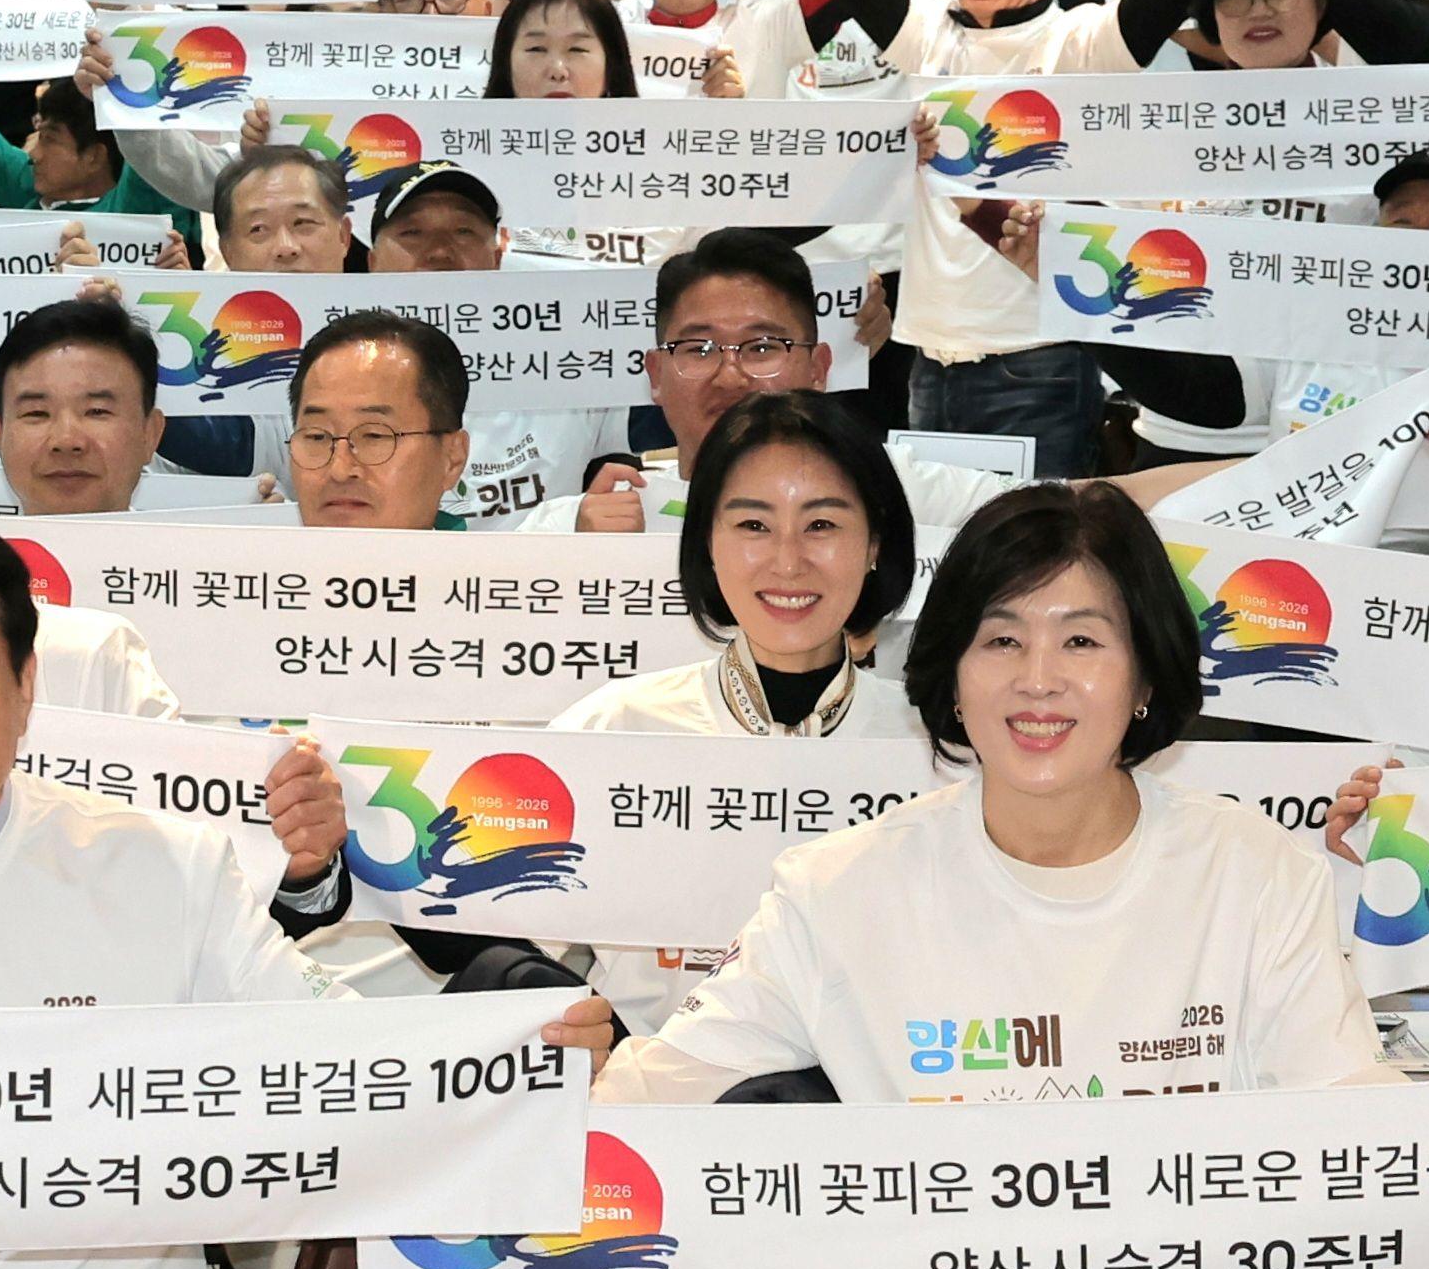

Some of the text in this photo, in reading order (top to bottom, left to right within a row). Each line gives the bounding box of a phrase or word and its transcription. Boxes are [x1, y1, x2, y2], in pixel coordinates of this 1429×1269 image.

[441, 126, 907, 155] 함께 꽃피운 30년 새로운 발걸음 100년
[1229, 251, 1281, 282] 함께
[1292, 256, 1373, 288] 꽃피운
[102, 566, 563, 613] 함께 꽃피운 30년 새로운
[472, 812, 549, 832] Yangsan
[609, 783, 833, 832] 함께 꽃피운
[1181, 1004, 1224, 1027] 2026
[906, 1014, 1062, 1074] 양산에
[1206, 1034, 1225, 1057] 해
[89, 1066, 241, 1120] 새로운
[261, 1059, 411, 1115] 발걸음
[429, 1043, 564, 1103] 100년
[702, 1163, 800, 1216] 함께
[821, 1162, 973, 1215] 꽃피운
[992, 1156, 1110, 1209] 30년
[1147, 1151, 1301, 1206] 새로운
